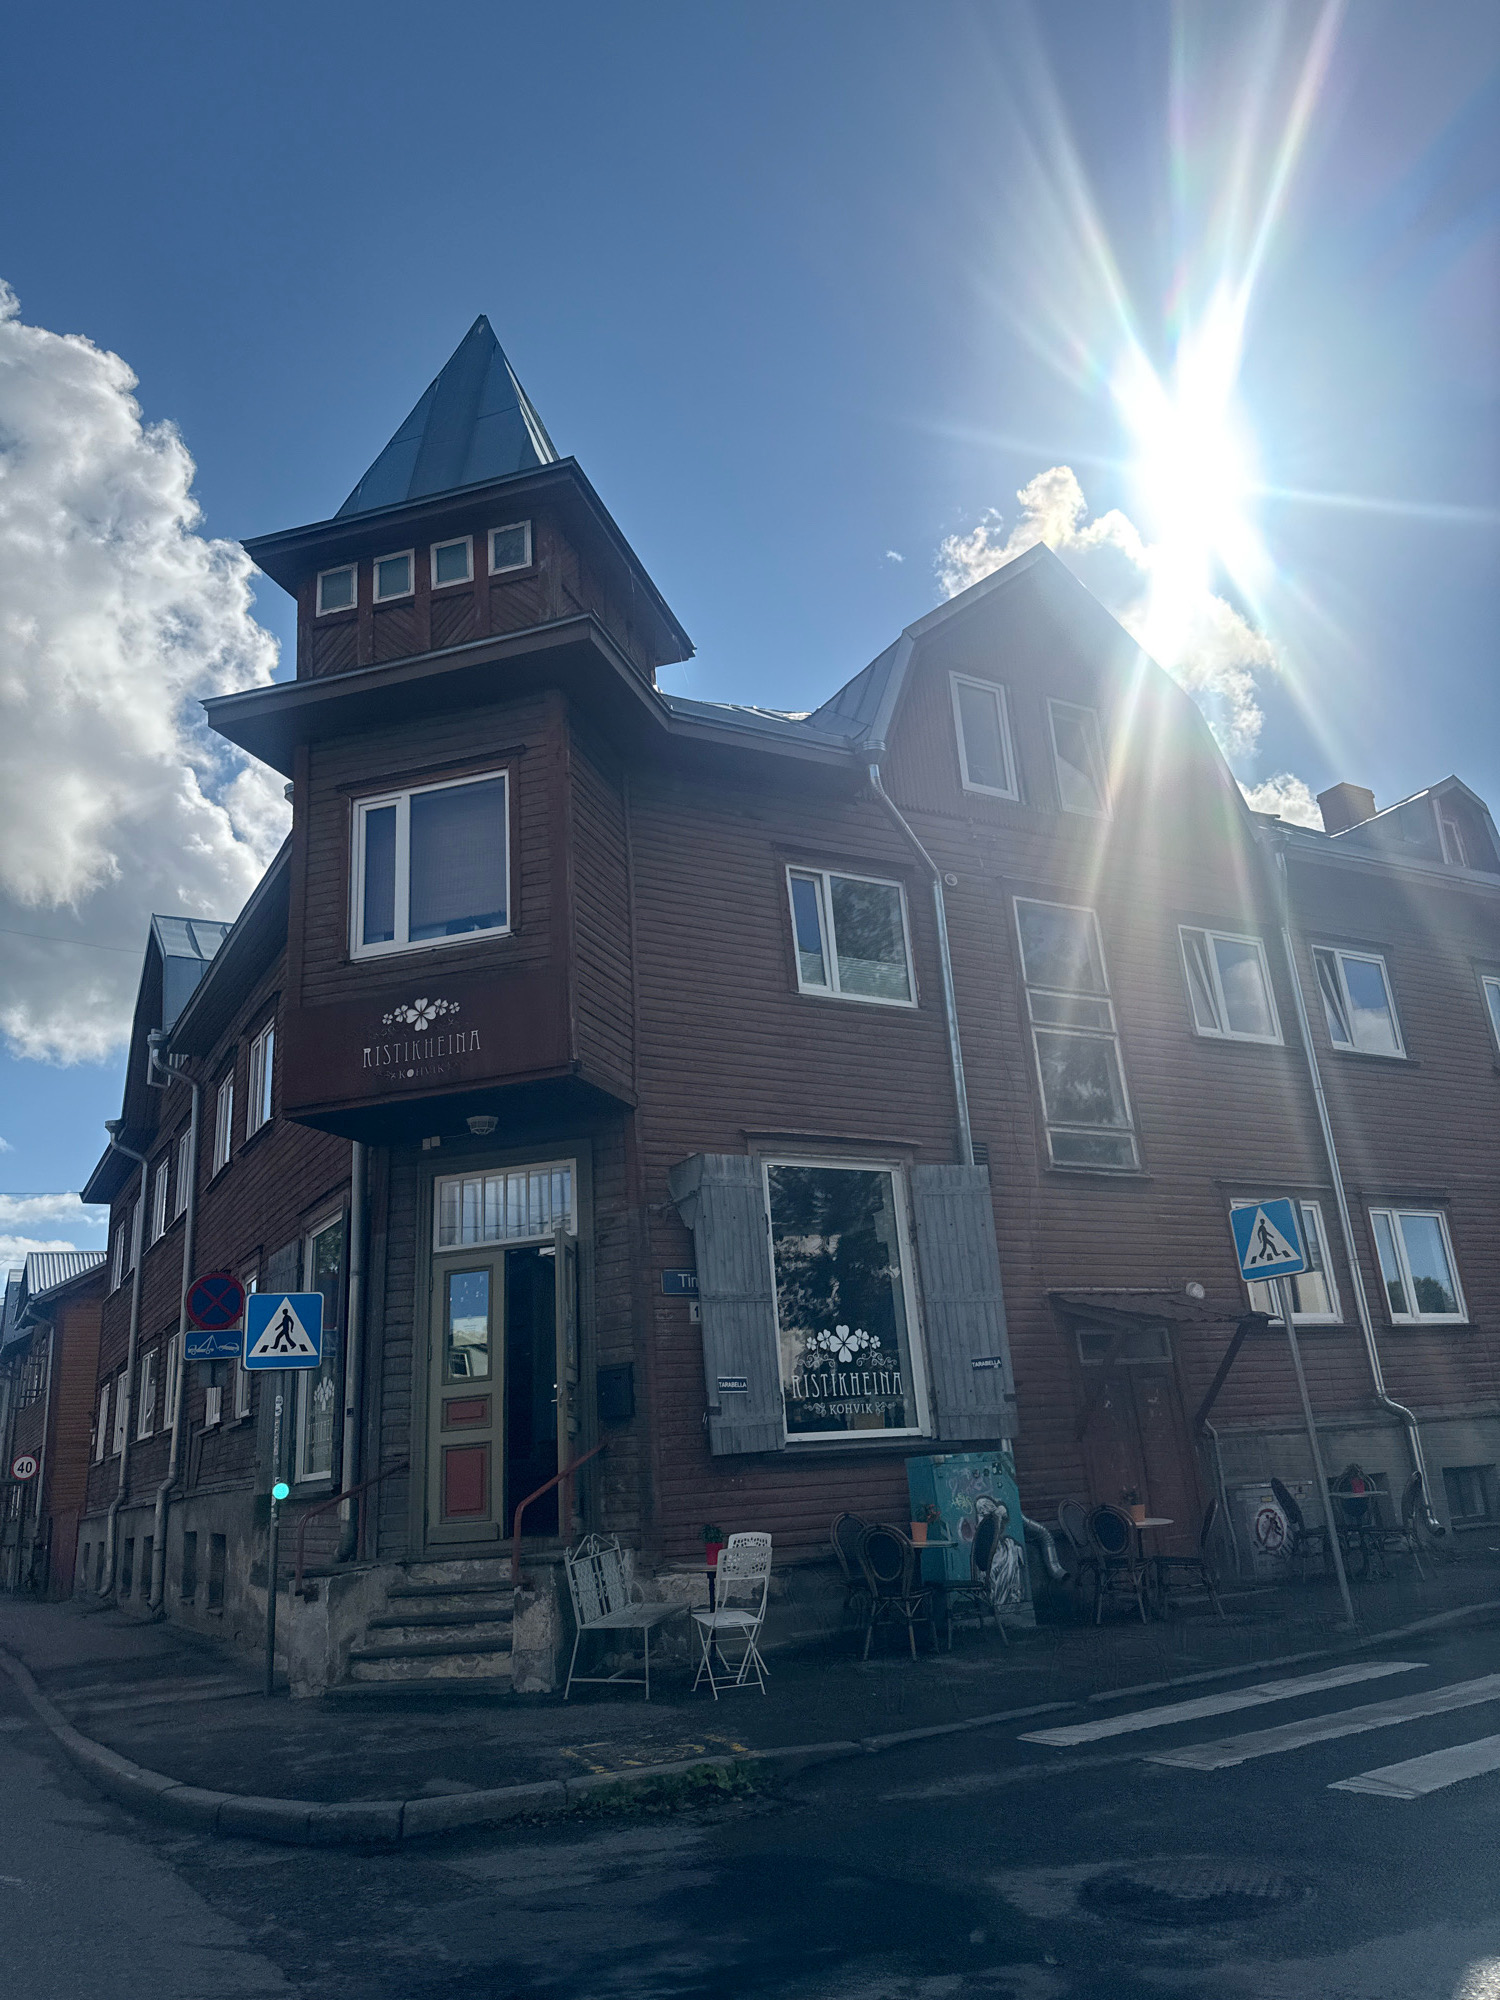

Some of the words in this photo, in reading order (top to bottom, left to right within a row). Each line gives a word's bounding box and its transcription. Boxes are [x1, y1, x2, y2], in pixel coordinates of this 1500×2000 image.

[363, 1029, 481, 1069] RISTIKHEINA
[791, 1371, 904, 1399] RISTIKHEINA
[829, 1403, 873, 1415] KOHVIK
[16, 1461, 33, 1474] 40
